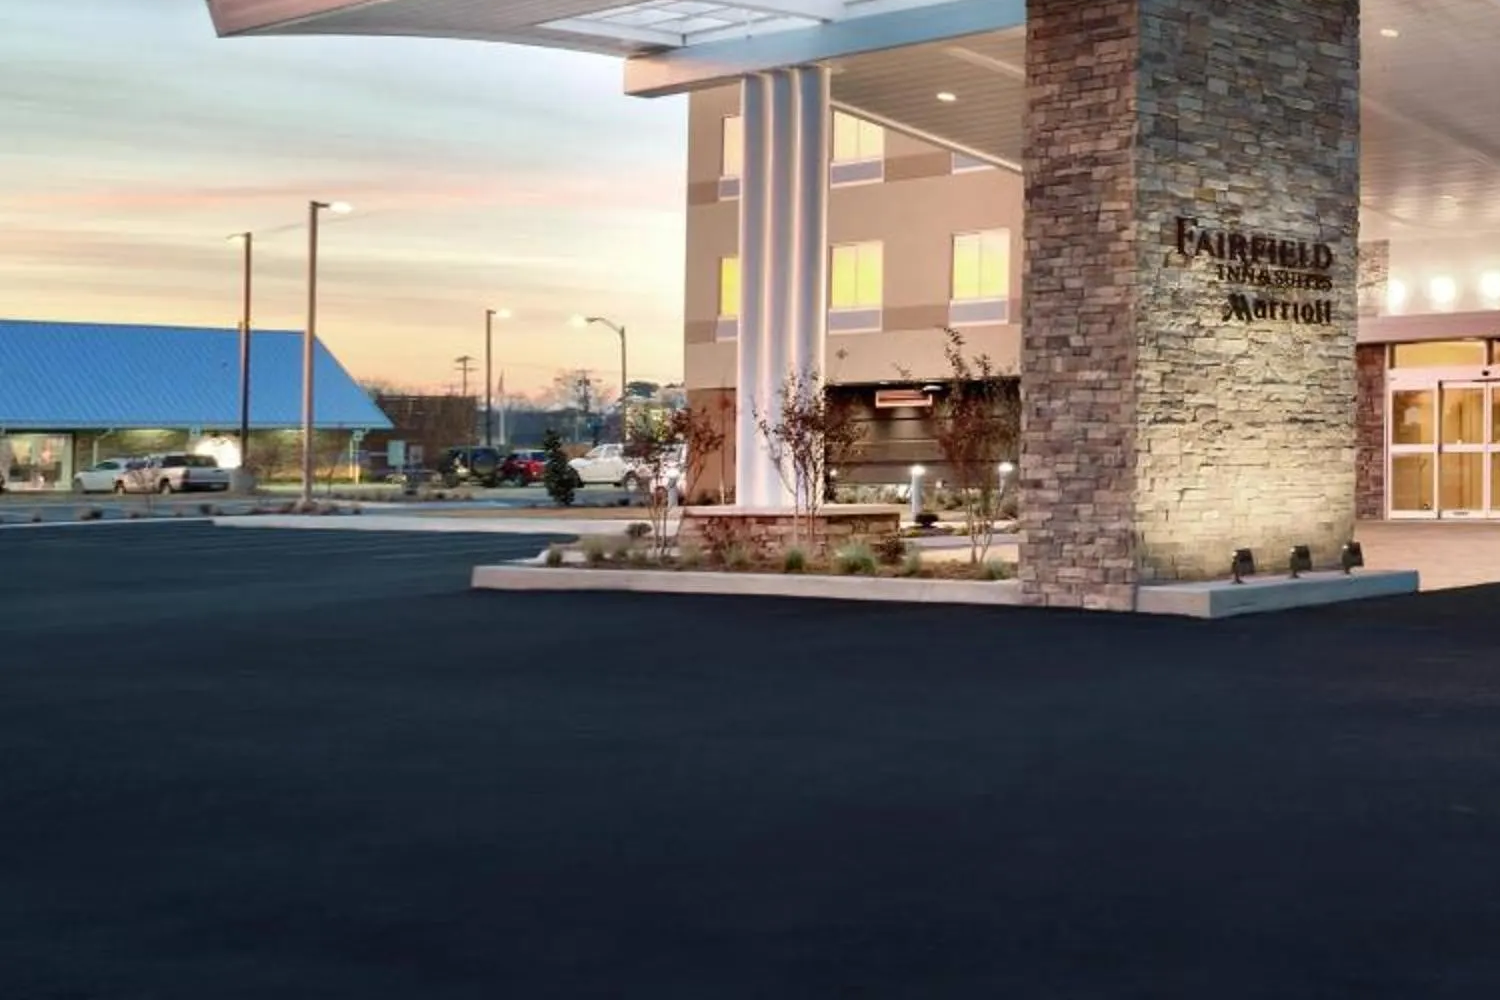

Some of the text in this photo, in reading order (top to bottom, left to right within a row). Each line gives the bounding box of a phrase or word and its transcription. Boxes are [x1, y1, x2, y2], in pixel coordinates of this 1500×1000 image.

[1175, 216, 1333, 271] FAIRFIELD
[1216, 263, 1256, 284] INN
[1221, 292, 1332, 325] Marriott
